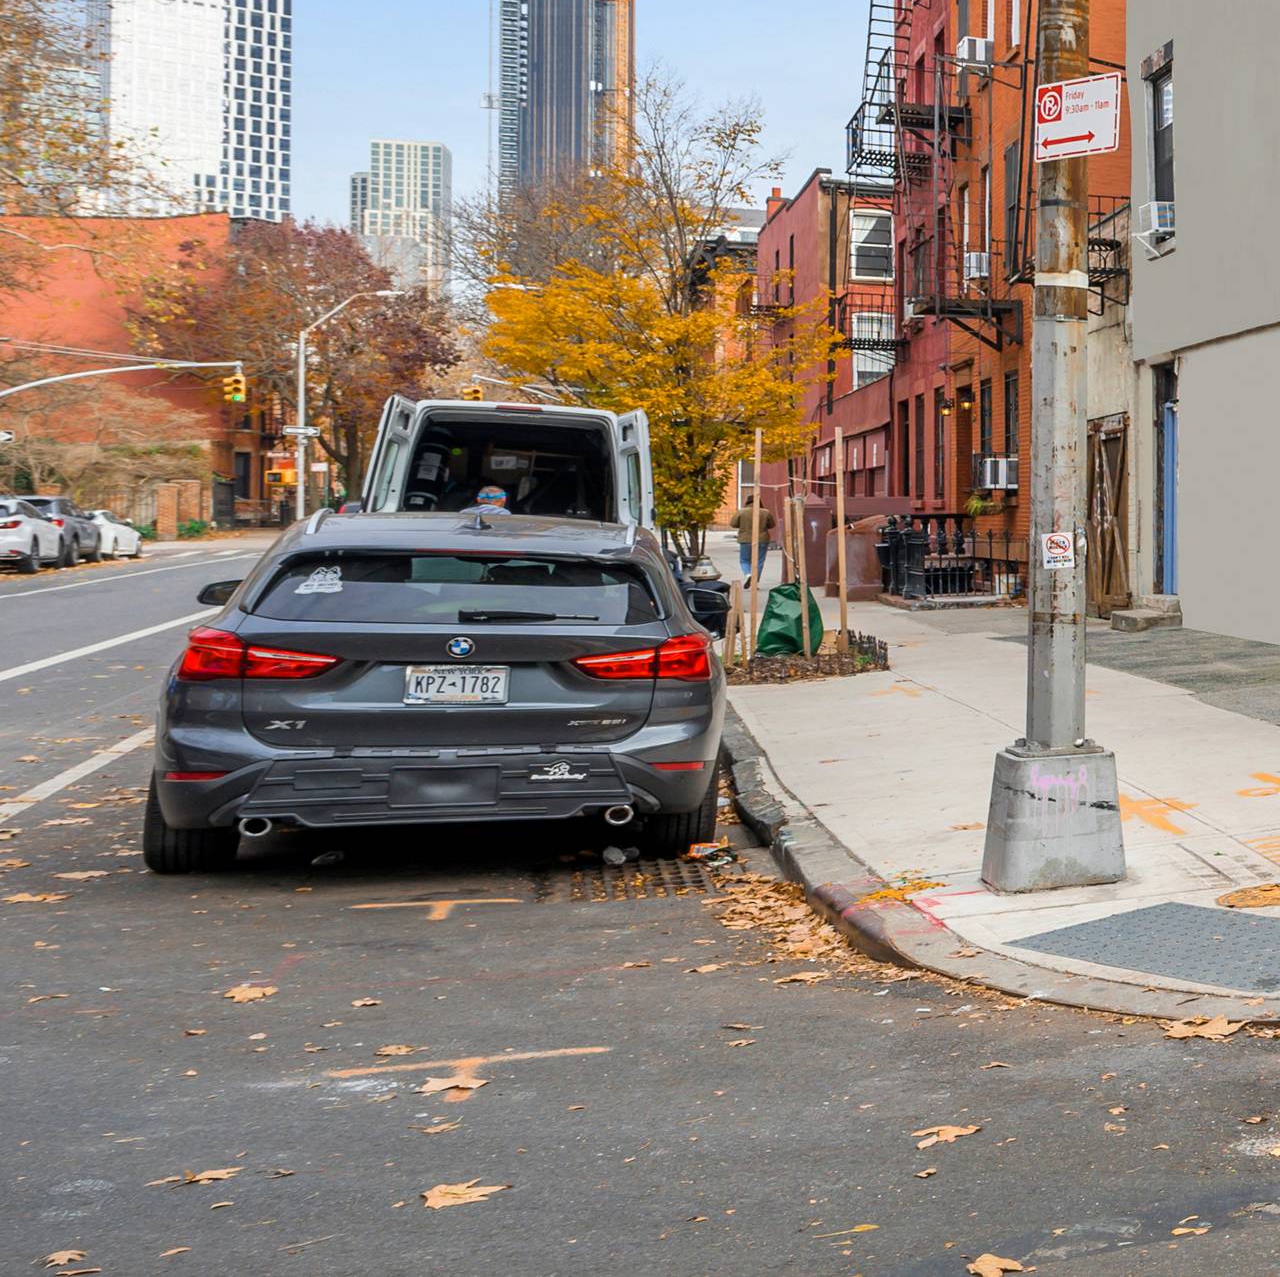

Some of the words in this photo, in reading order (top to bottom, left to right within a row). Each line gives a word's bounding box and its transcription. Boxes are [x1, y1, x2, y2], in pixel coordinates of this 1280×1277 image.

[1065, 90, 1084, 101] Friday
[434, 667, 456, 675] NEW
[459, 667, 485, 675] YORK
[414, 676, 447, 694] KPZ
[460, 676, 501, 694] 1782
[264, 720, 306, 730] X1
